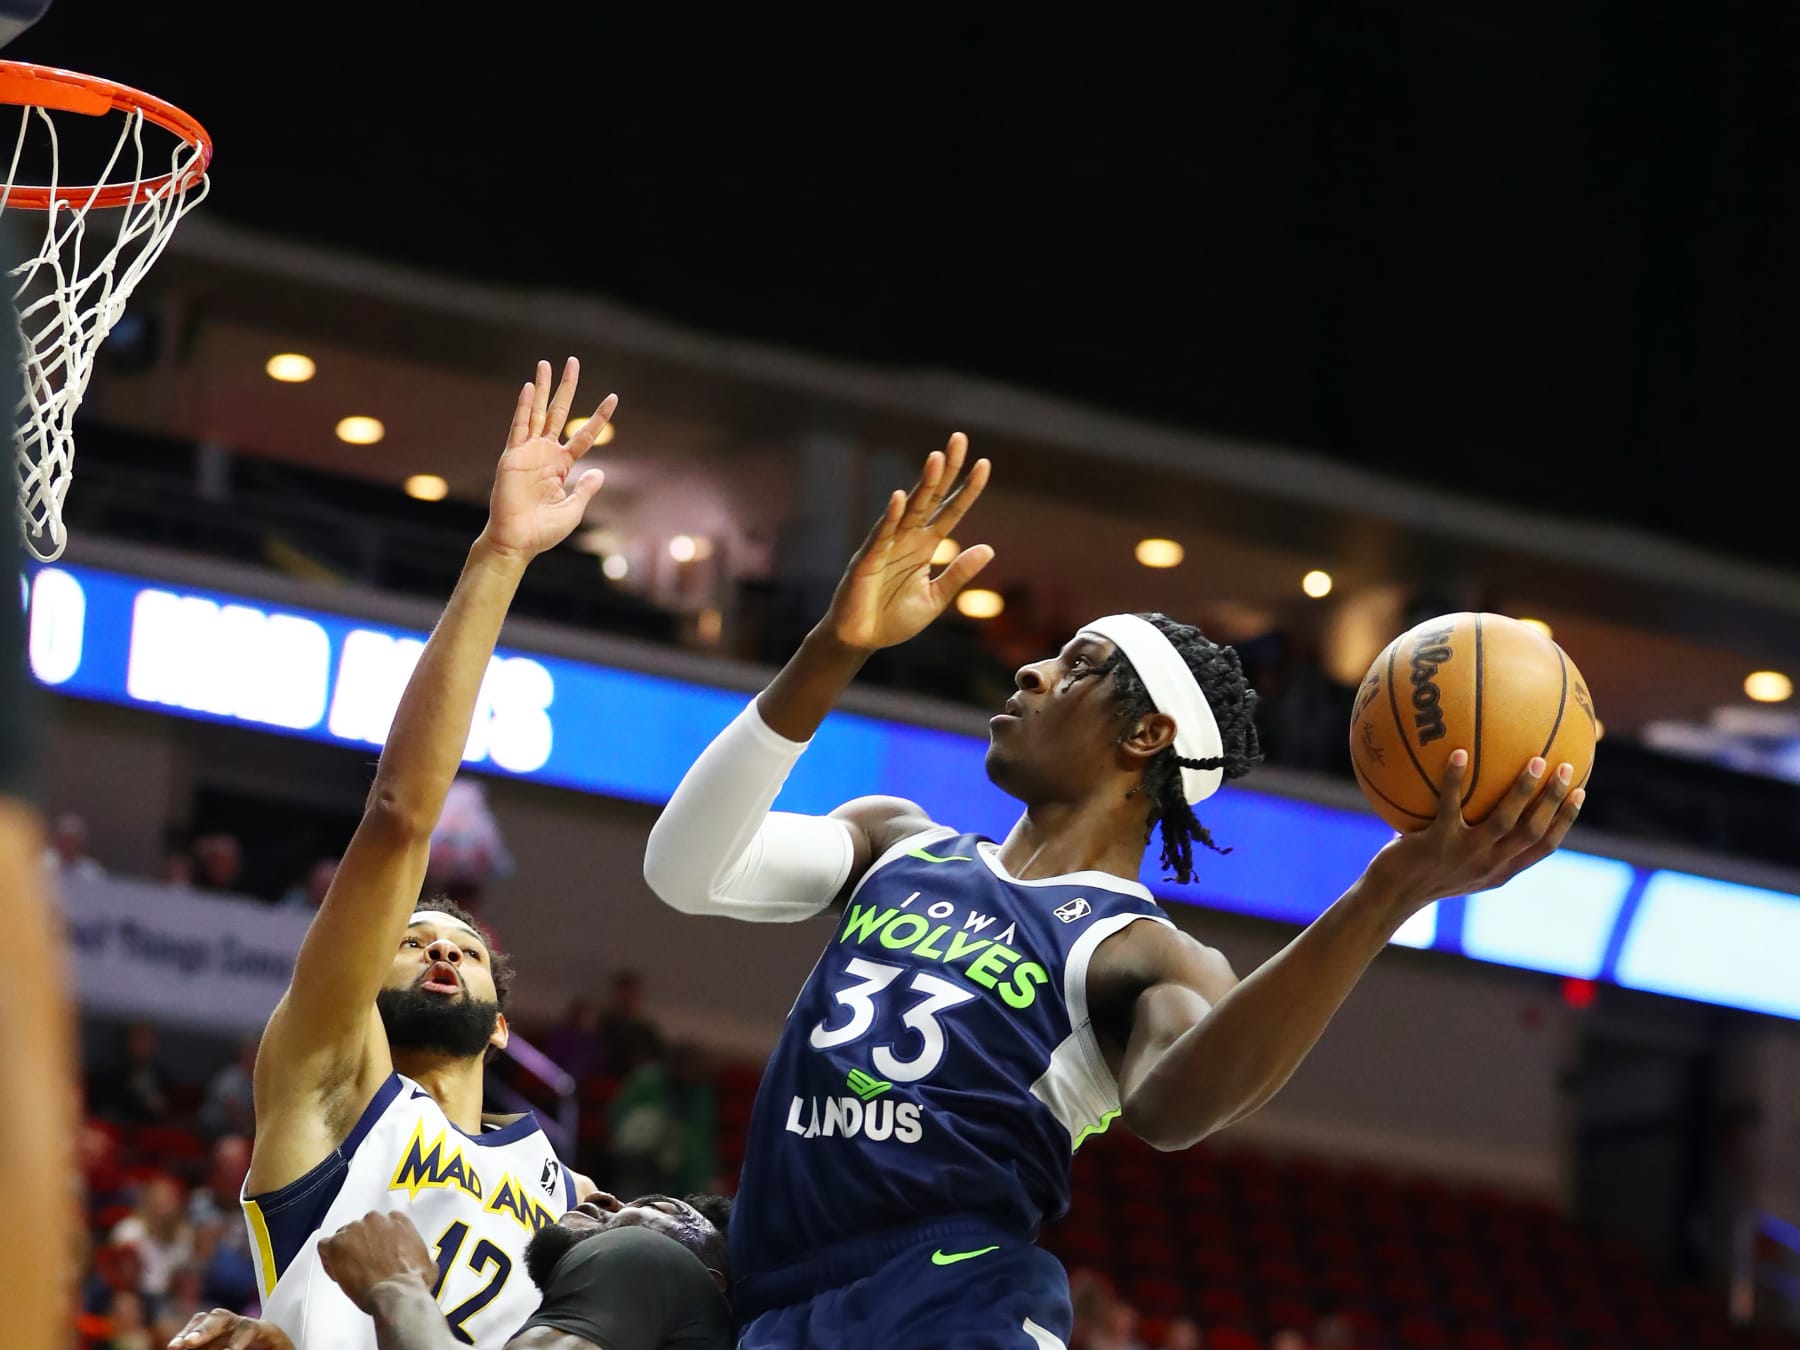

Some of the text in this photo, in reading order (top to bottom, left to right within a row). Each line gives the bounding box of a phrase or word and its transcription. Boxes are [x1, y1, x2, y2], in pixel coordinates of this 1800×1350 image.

[840, 904, 1048, 1009] WOLVES
[900, 891, 1016, 944] IOWA
[809, 958, 978, 1082] 33
[389, 1117, 483, 1201] MAD
[786, 1095, 923, 1144] LANDUS
[433, 1218, 513, 1346] 12
